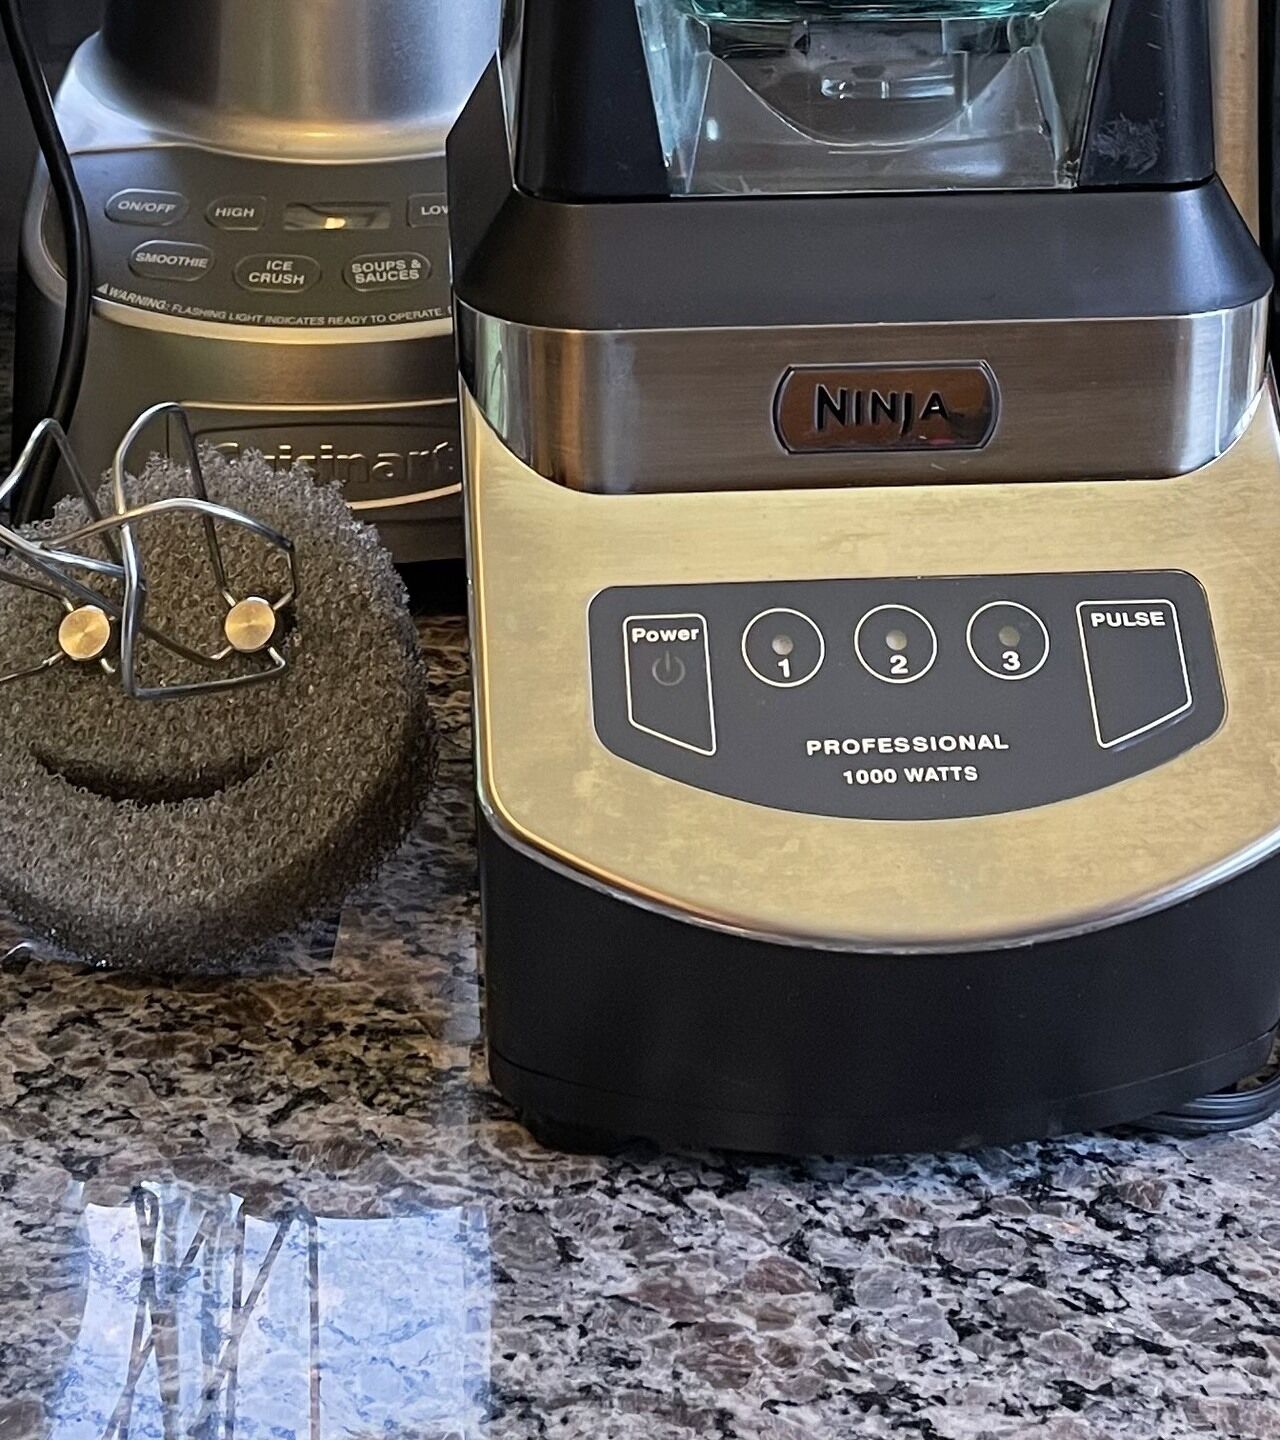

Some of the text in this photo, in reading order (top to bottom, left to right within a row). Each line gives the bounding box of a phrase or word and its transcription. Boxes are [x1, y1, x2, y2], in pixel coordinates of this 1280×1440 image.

[117, 199, 177, 214] ON/OFF
[214, 207, 255, 218] HIGH
[134, 251, 210, 270] SMOOTHIE
[266, 259, 294, 272] ICE
[351, 258, 422, 274] SOUPS &
[248, 271, 305, 285] CRUSH
[354, 268, 420, 285] SAUCES
[170, 303, 227, 321] FLASHING
[228, 313, 263, 324] LIGHT
[264, 315, 325, 326] INDICATES
[327, 315, 368, 326] READY
[370, 314, 386, 324] TO
[814, 383, 949, 437] NINJA
[1090, 610, 1166, 628] PULSE
[630, 627, 701, 644] Power
[777, 658, 792, 678] 1
[889, 654, 910, 675] 2
[1001, 650, 1022, 671] 3
[805, 733, 1011, 757] PROFESSIONAL
[842, 765, 979, 785] 1000 WATTS
